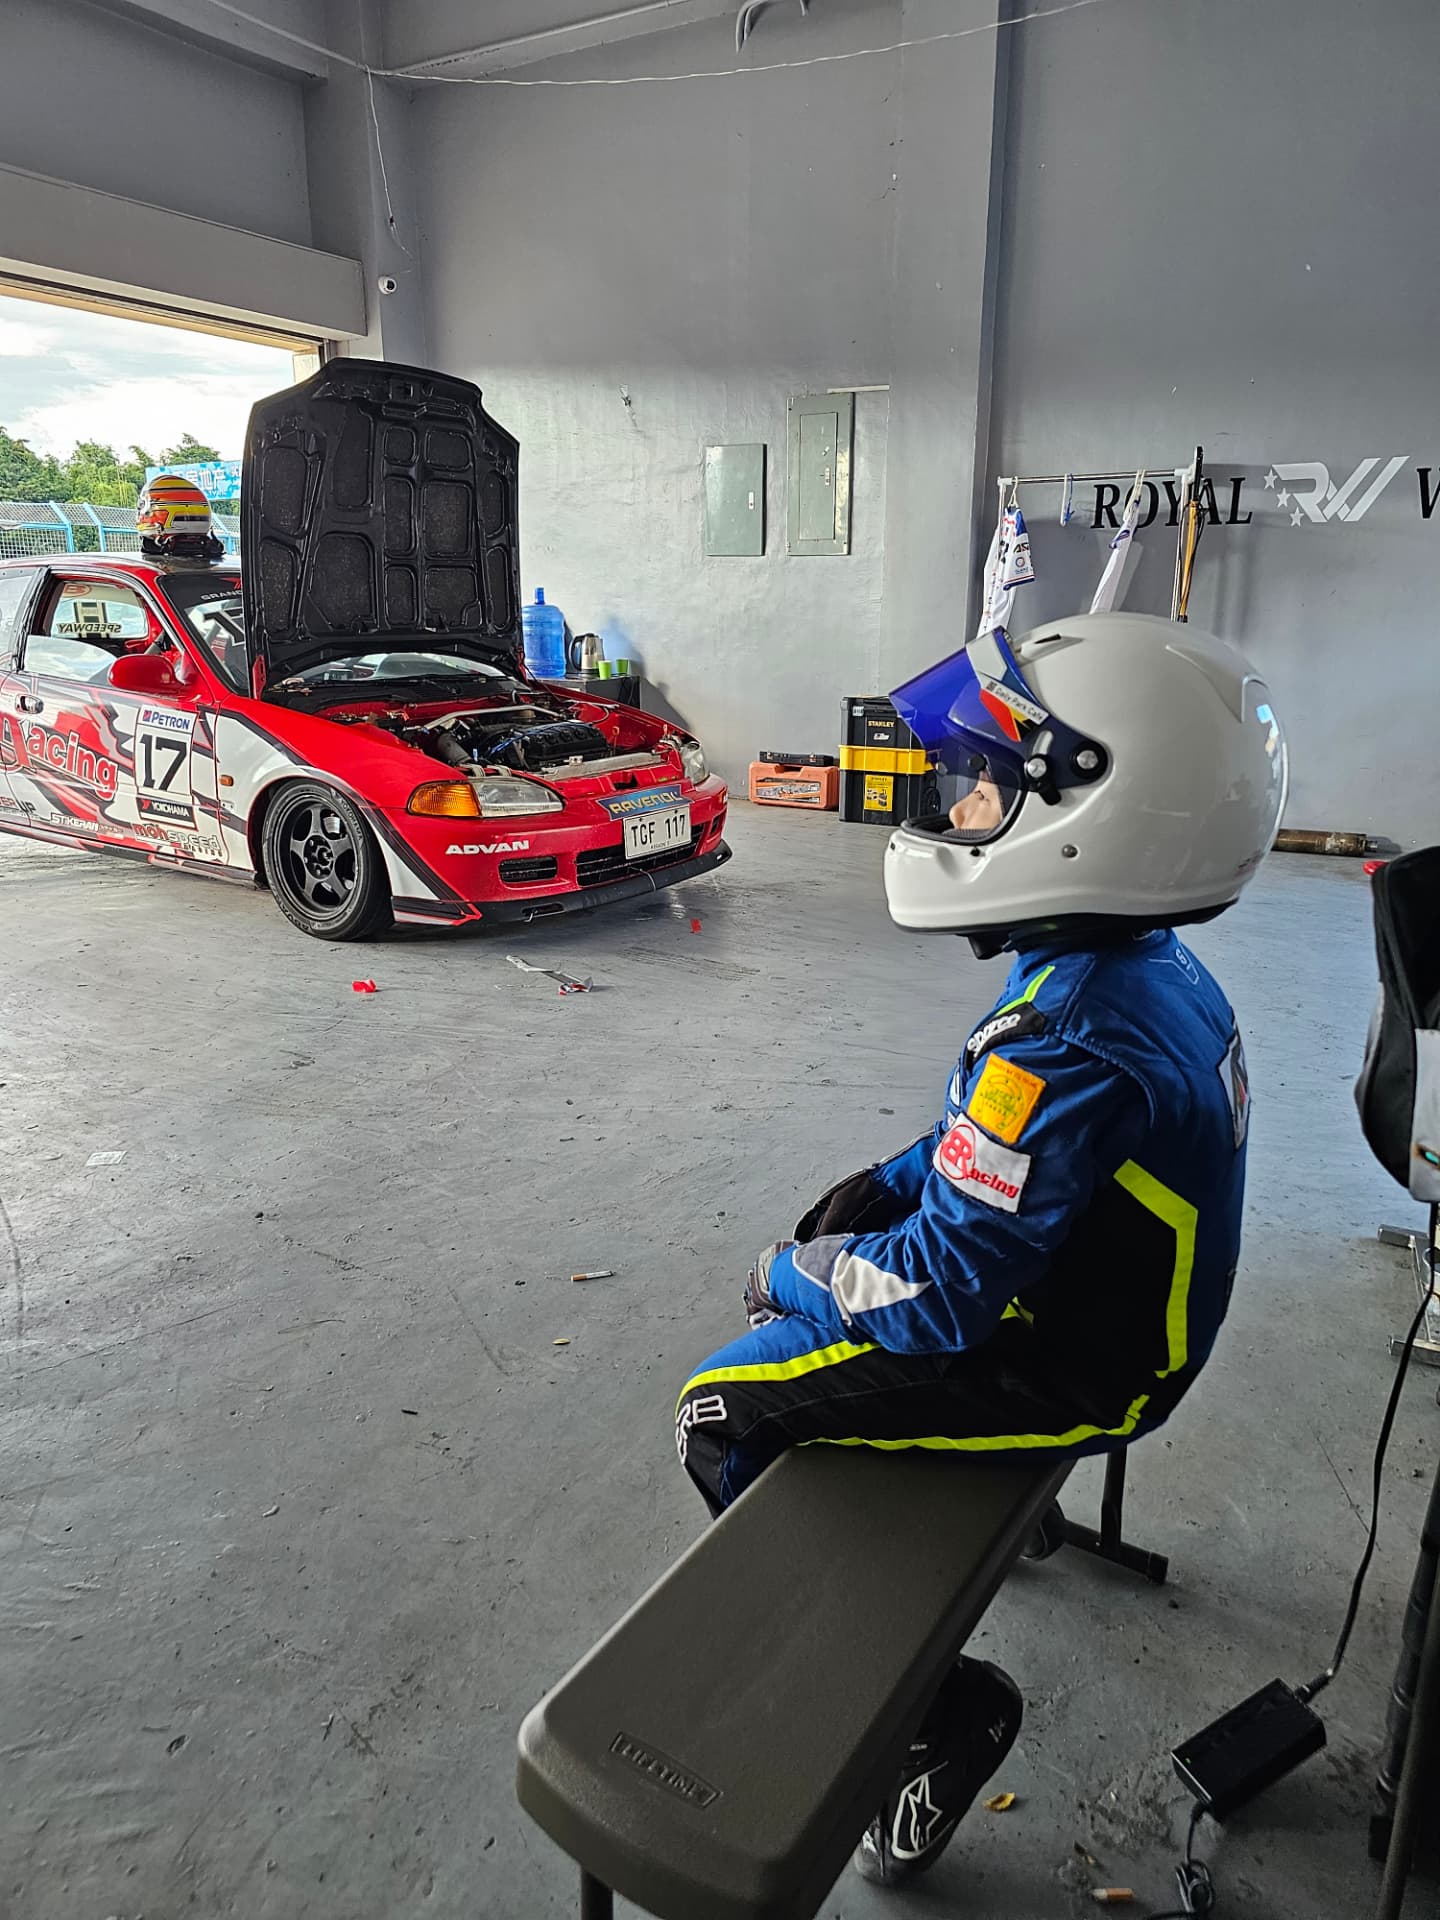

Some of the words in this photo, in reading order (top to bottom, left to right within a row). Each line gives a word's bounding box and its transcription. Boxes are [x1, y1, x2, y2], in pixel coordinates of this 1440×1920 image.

[1090, 477, 1253, 529] ROYAL
[151, 711, 190, 730] PETRON
[867, 720, 895, 728] STANLEY
[139, 734, 187, 792] 17
[152, 801, 190, 817] YOKOHAMA
[608, 791, 684, 814] RAVENOL
[631, 822, 656, 847] TGF
[665, 814, 686, 839] 117
[445, 840, 530, 855] ADVAN
